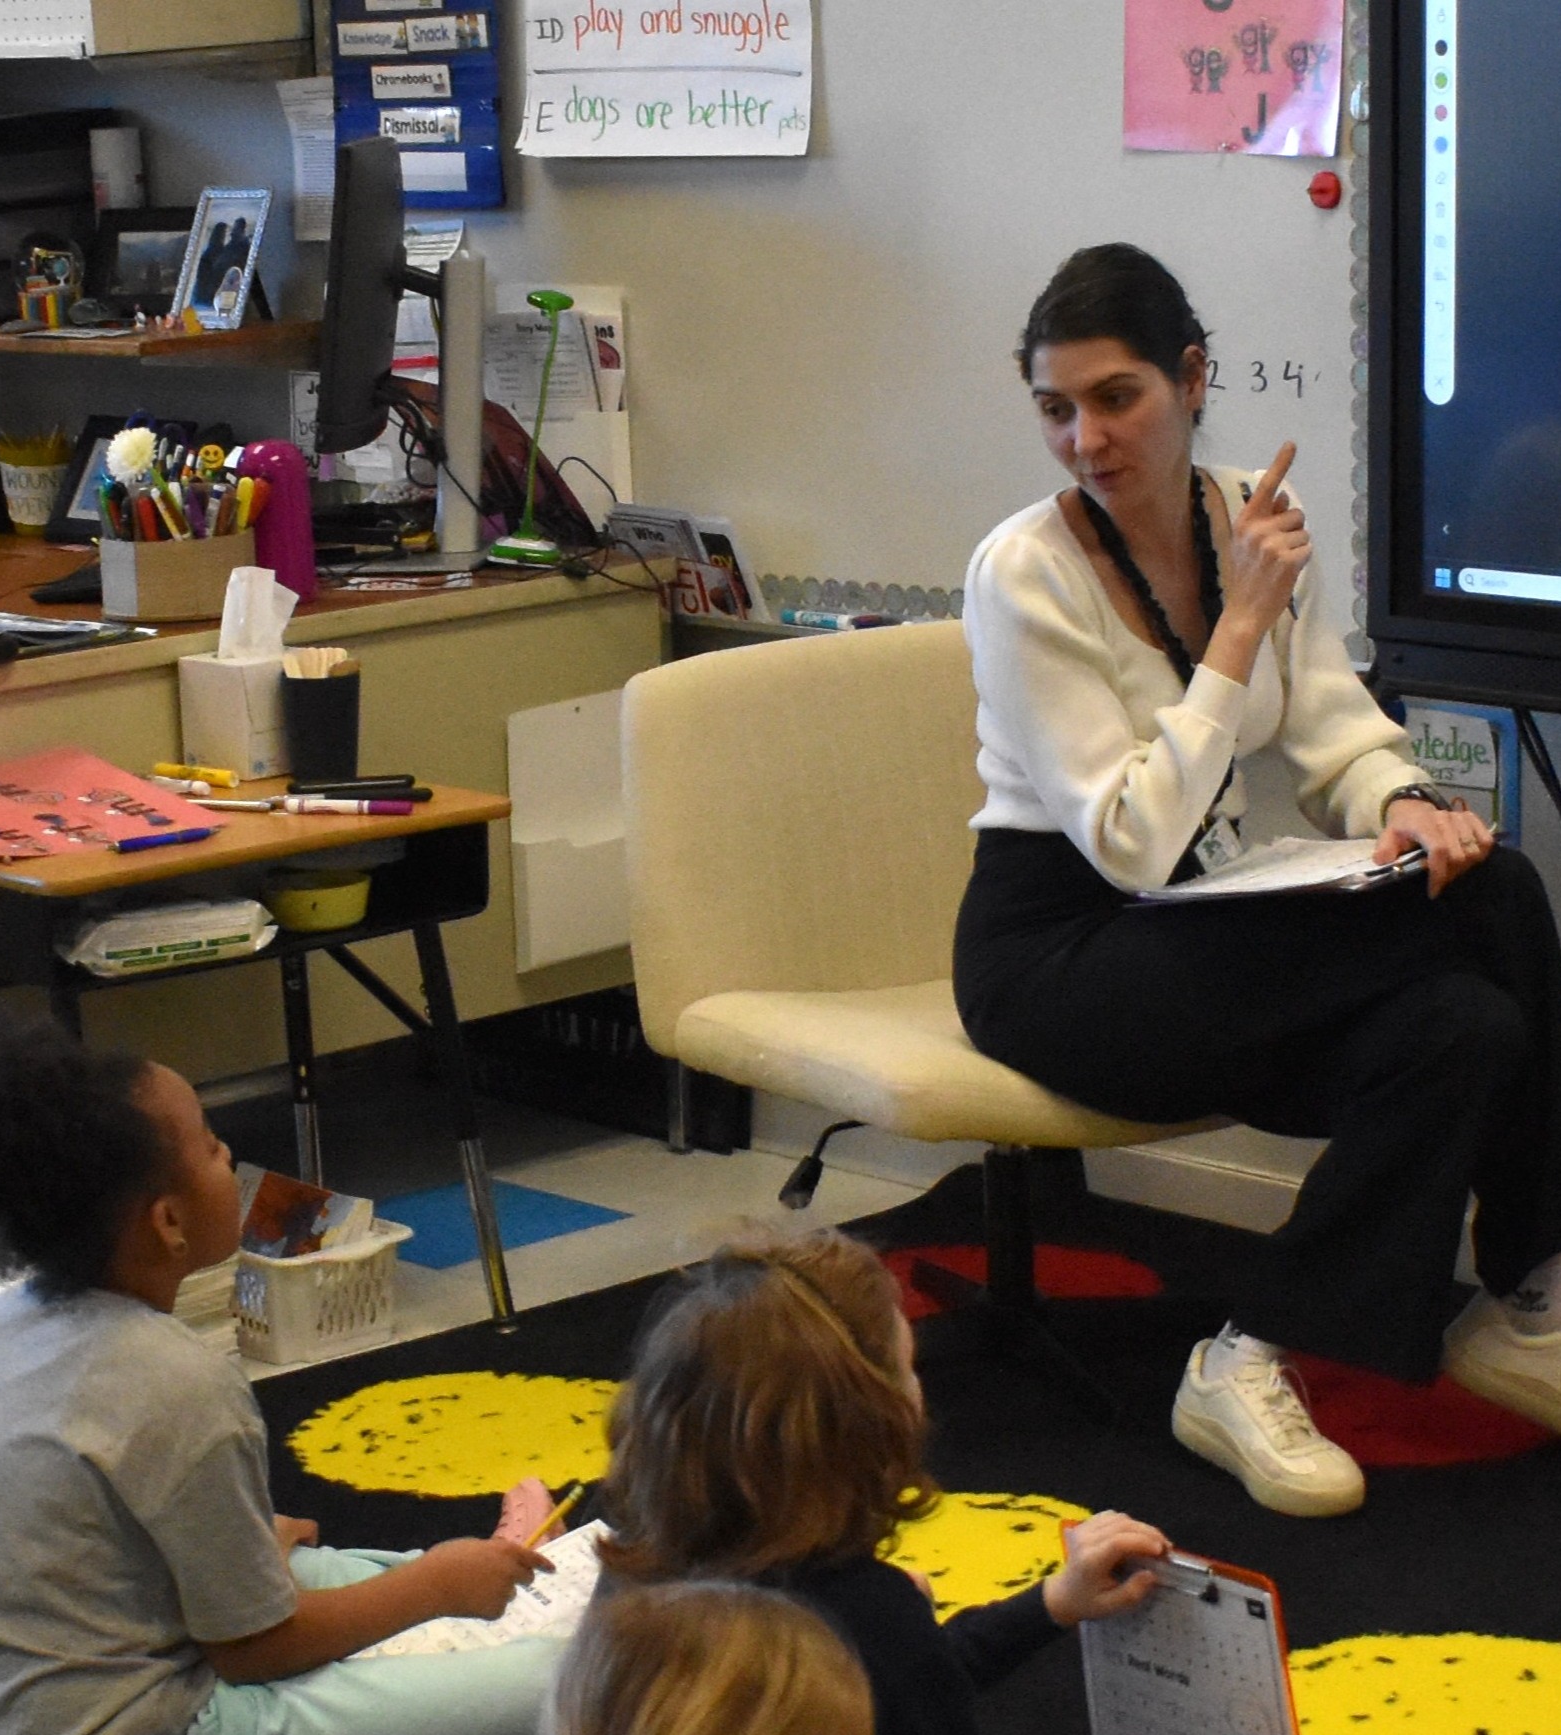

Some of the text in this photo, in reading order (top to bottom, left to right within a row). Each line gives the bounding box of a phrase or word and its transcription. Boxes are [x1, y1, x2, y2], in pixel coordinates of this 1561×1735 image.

[412, 25, 450, 43] Snack
[536, 0, 791, 53] ID play and snuggle
[384, 115, 439, 135] Dismissal
[536, 101, 554, 133] E
[565, 85, 620, 141] dogs
[636, 101, 674, 130] are
[687, 89, 773, 129] better
[1250, 360, 1268, 393] 3
